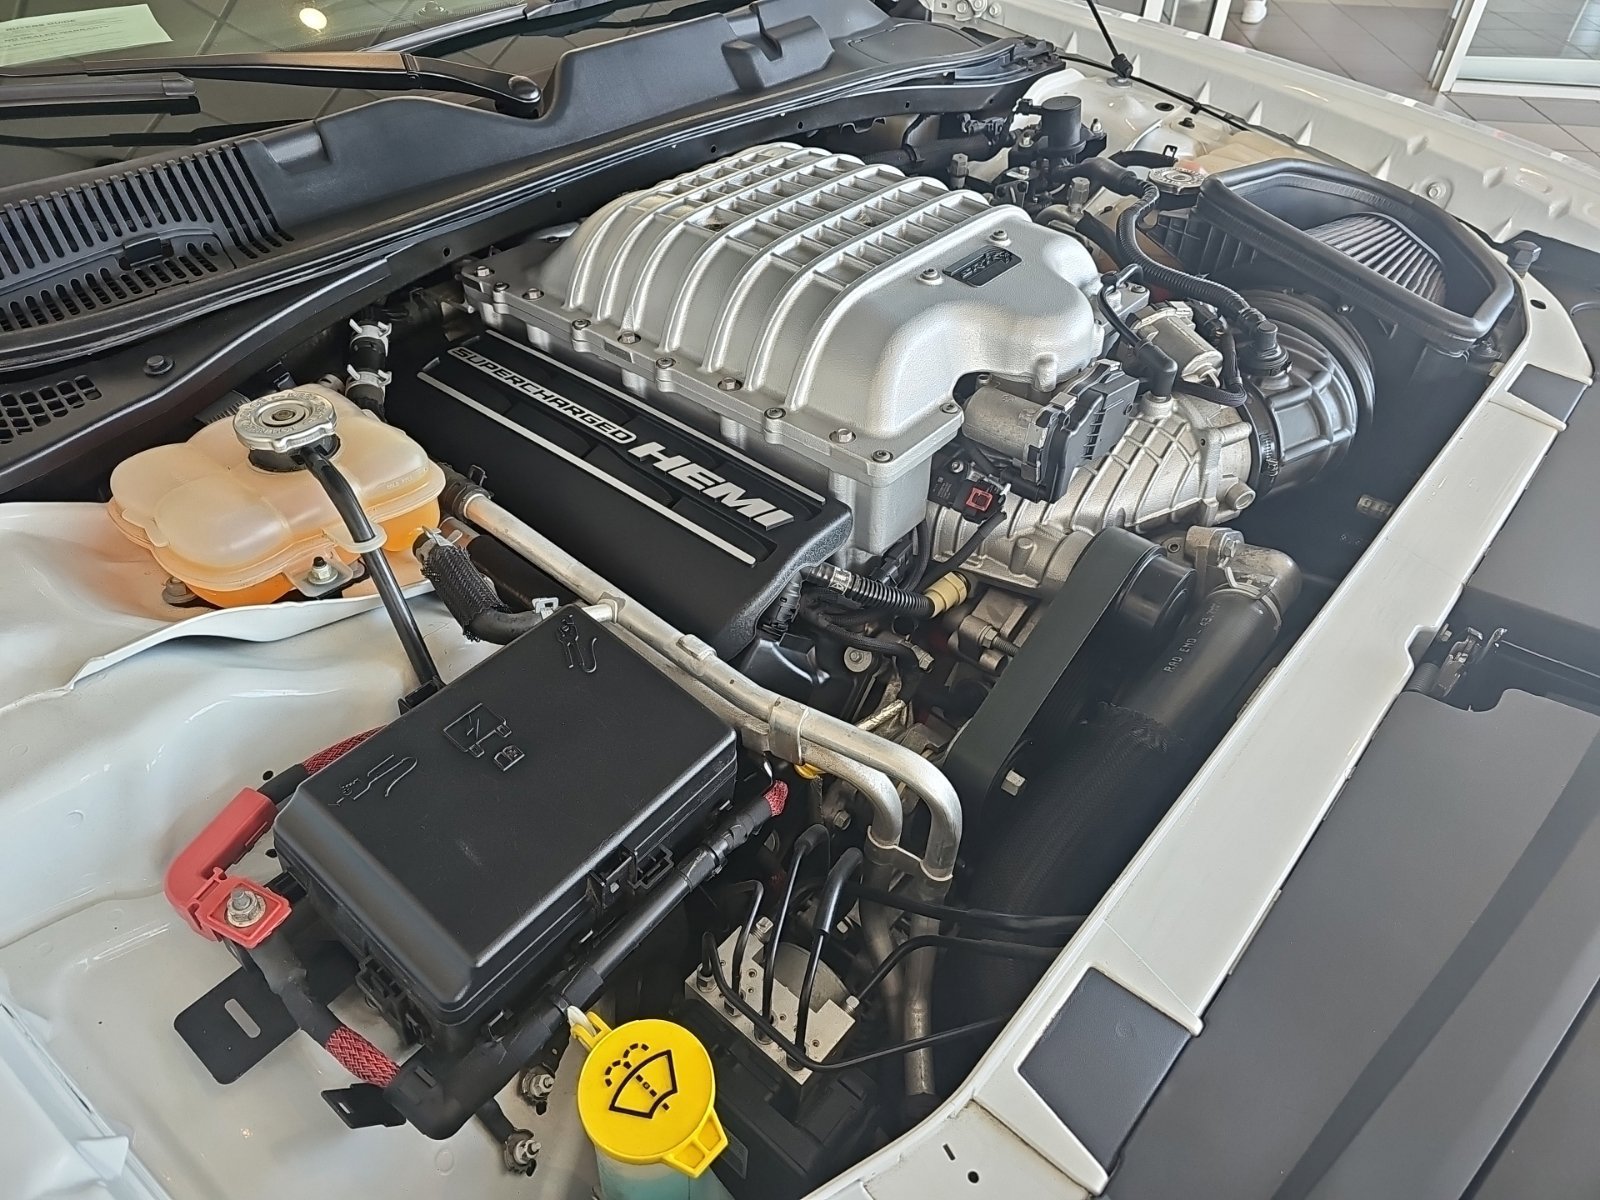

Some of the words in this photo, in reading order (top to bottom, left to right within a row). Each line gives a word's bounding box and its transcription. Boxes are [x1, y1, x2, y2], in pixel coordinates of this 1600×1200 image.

[449, 347, 637, 444] SUPERCHARGED
[628, 441, 796, 530] HEMI
[1163, 656, 1183, 673] RAD
[1179, 638, 1197, 653] END
